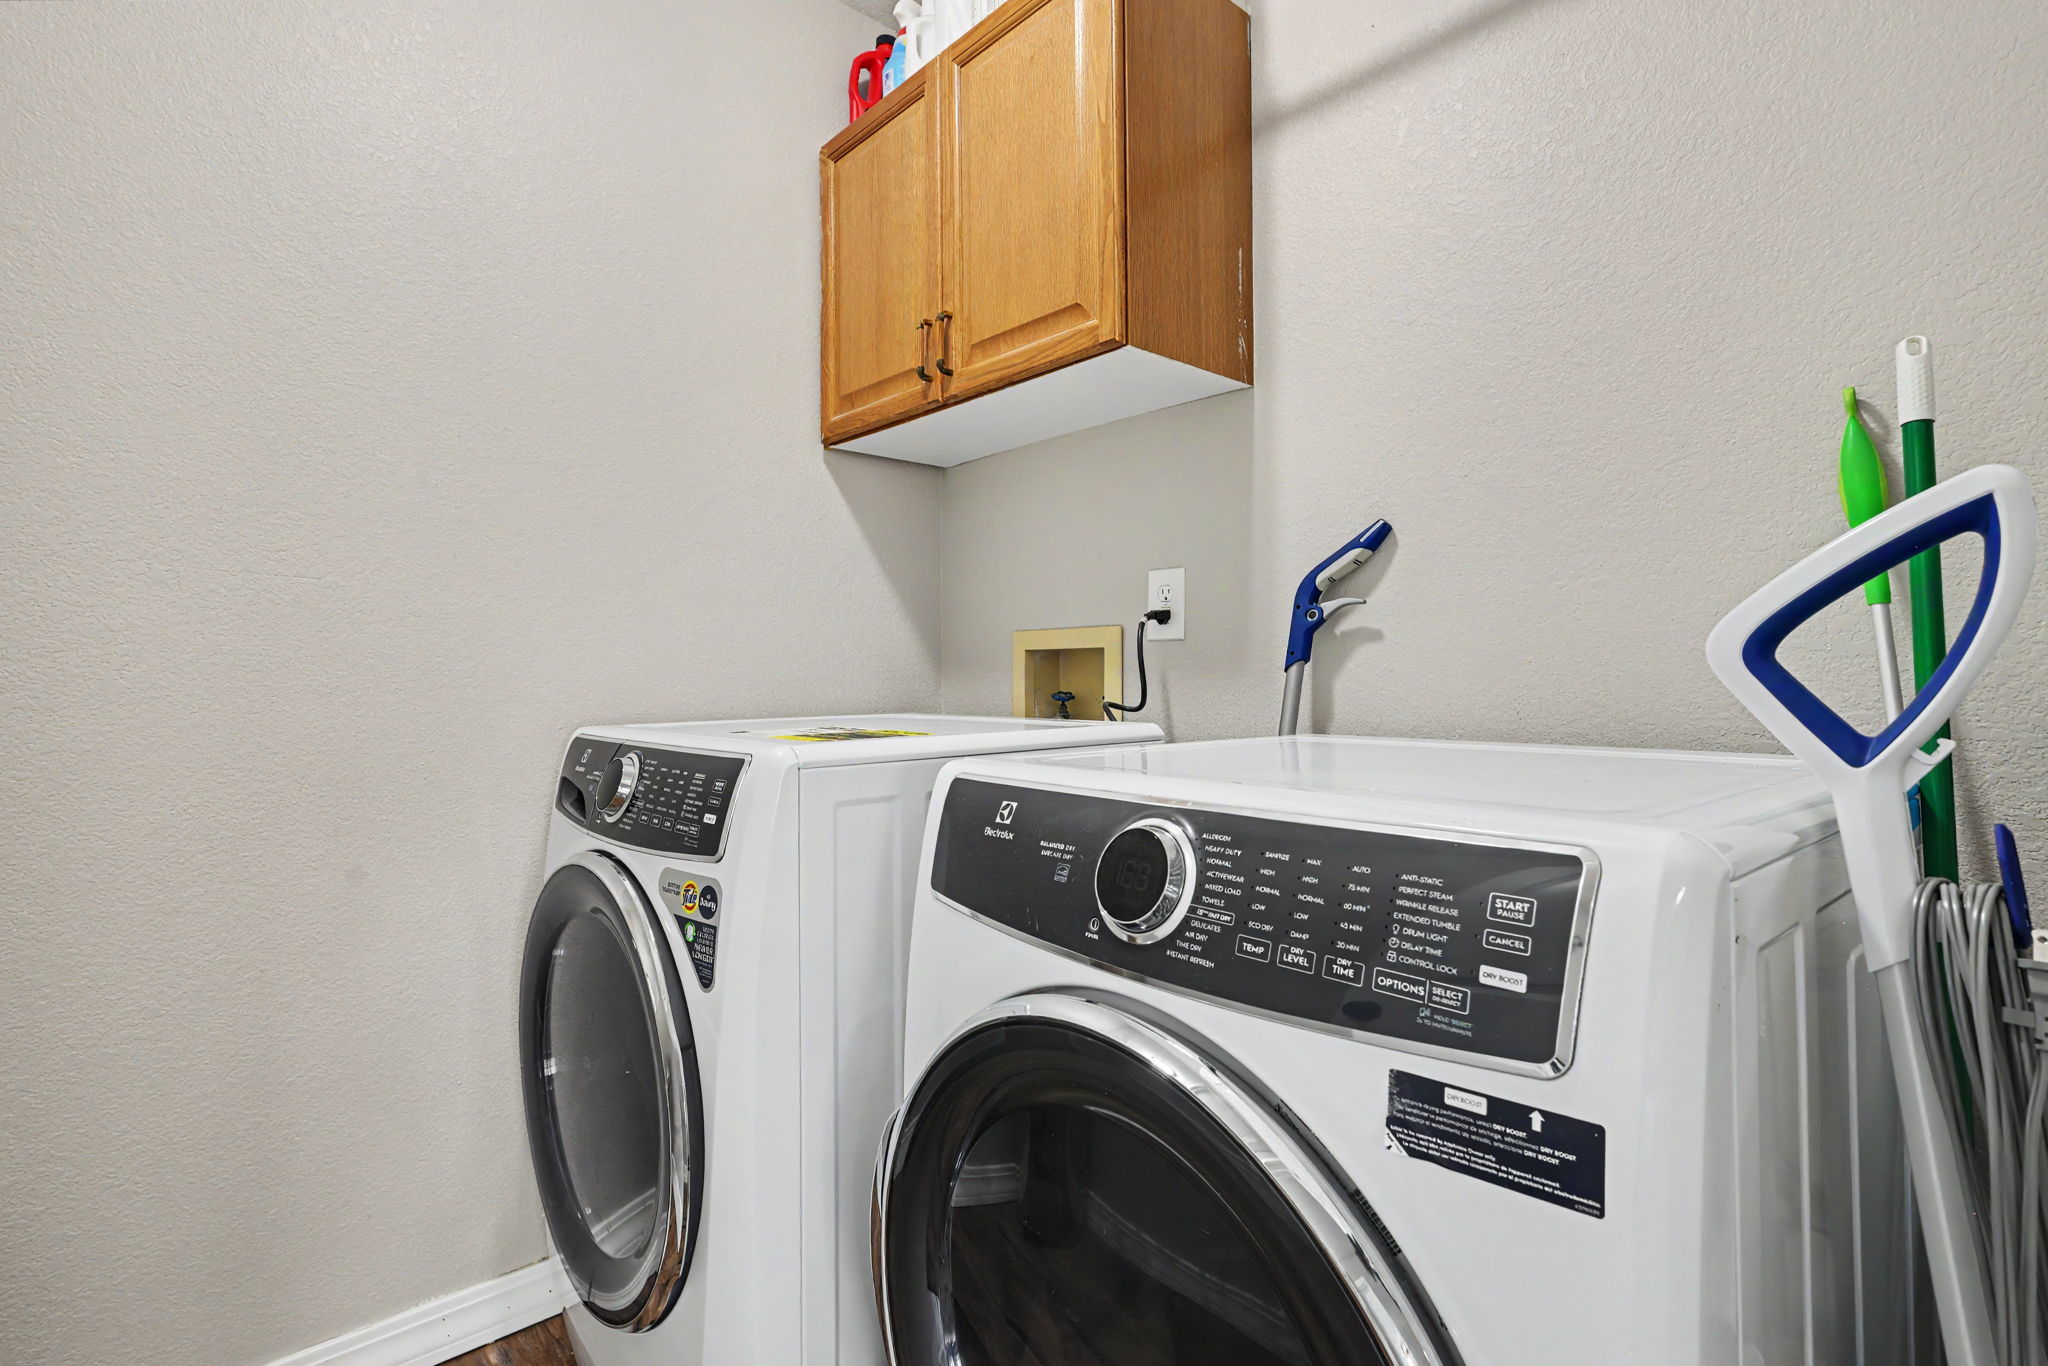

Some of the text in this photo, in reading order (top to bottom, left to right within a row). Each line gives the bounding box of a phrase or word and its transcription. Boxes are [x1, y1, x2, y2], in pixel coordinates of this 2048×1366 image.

[984, 826, 1015, 840] Electrolux
[1202, 833, 1231, 842] ALLERGEN
[1205, 845, 1242, 857] HEAVY DUTY
[1265, 852, 1290, 861] SANITIZE
[1206, 858, 1232, 868] NORMAL
[1352, 866, 1371, 874] AUTO
[1206, 871, 1244, 883] ACTIVEWEAR
[1401, 874, 1444, 887] ANTI-STATIC
[1204, 883, 1241, 896] MIXED LOAD
[1255, 886, 1281, 896] NORMAL
[1356, 885, 1371, 893] MIN
[1399, 886, 1453, 901] PERFECT STEAM
[682, 888, 697, 906] Tide
[1202, 896, 1225, 907] TOWELS
[1297, 894, 1325, 905] NORMAL
[1252, 903, 1266, 911] LOW
[1396, 898, 1459, 917] WRINKLE RELEASE
[1495, 899, 1531, 913] START
[1293, 912, 1309, 920] LOW
[1497, 908, 1526, 921] PAUSE
[1191, 920, 1221, 933] DELICATES
[1261, 922, 1274, 932] DRY
[1349, 923, 1363, 932] MIN
[1393, 912, 1462, 932] EXTENDED TUMBLE
[1185, 931, 1209, 941] AIR DRY
[1290, 931, 1310, 940] DAMP
[1402, 927, 1448, 944] DRUM LIGHT
[1176, 940, 1202, 952] TIME DRY
[1242, 942, 1265, 954] TEMP
[1345, 943, 1360, 952] MIN
[1489, 935, 1526, 950] CANCEL
[1290, 946, 1304, 955] DRY
[1401, 941, 1443, 957] DELAY TIME
[1166, 949, 1215, 968] INSTANT REFRESH
[1283, 953, 1309, 967] LEVEL
[1337, 957, 1352, 967] DRY
[1332, 964, 1355, 978] TIME
[1398, 955, 1458, 976] CONTROL LOCK
[1482, 971, 1524, 987] DRY BOOST
[1377, 976, 1425, 996] OPTIONS
[1432, 986, 1464, 1001] SELECT
[1447, 1093, 1482, 1108] DRY BOOST
[1492, 1123, 1505, 1132] DRY
[1523, 1150, 1537, 1158] DRY
[1540, 1146, 1553, 1155] DRY
